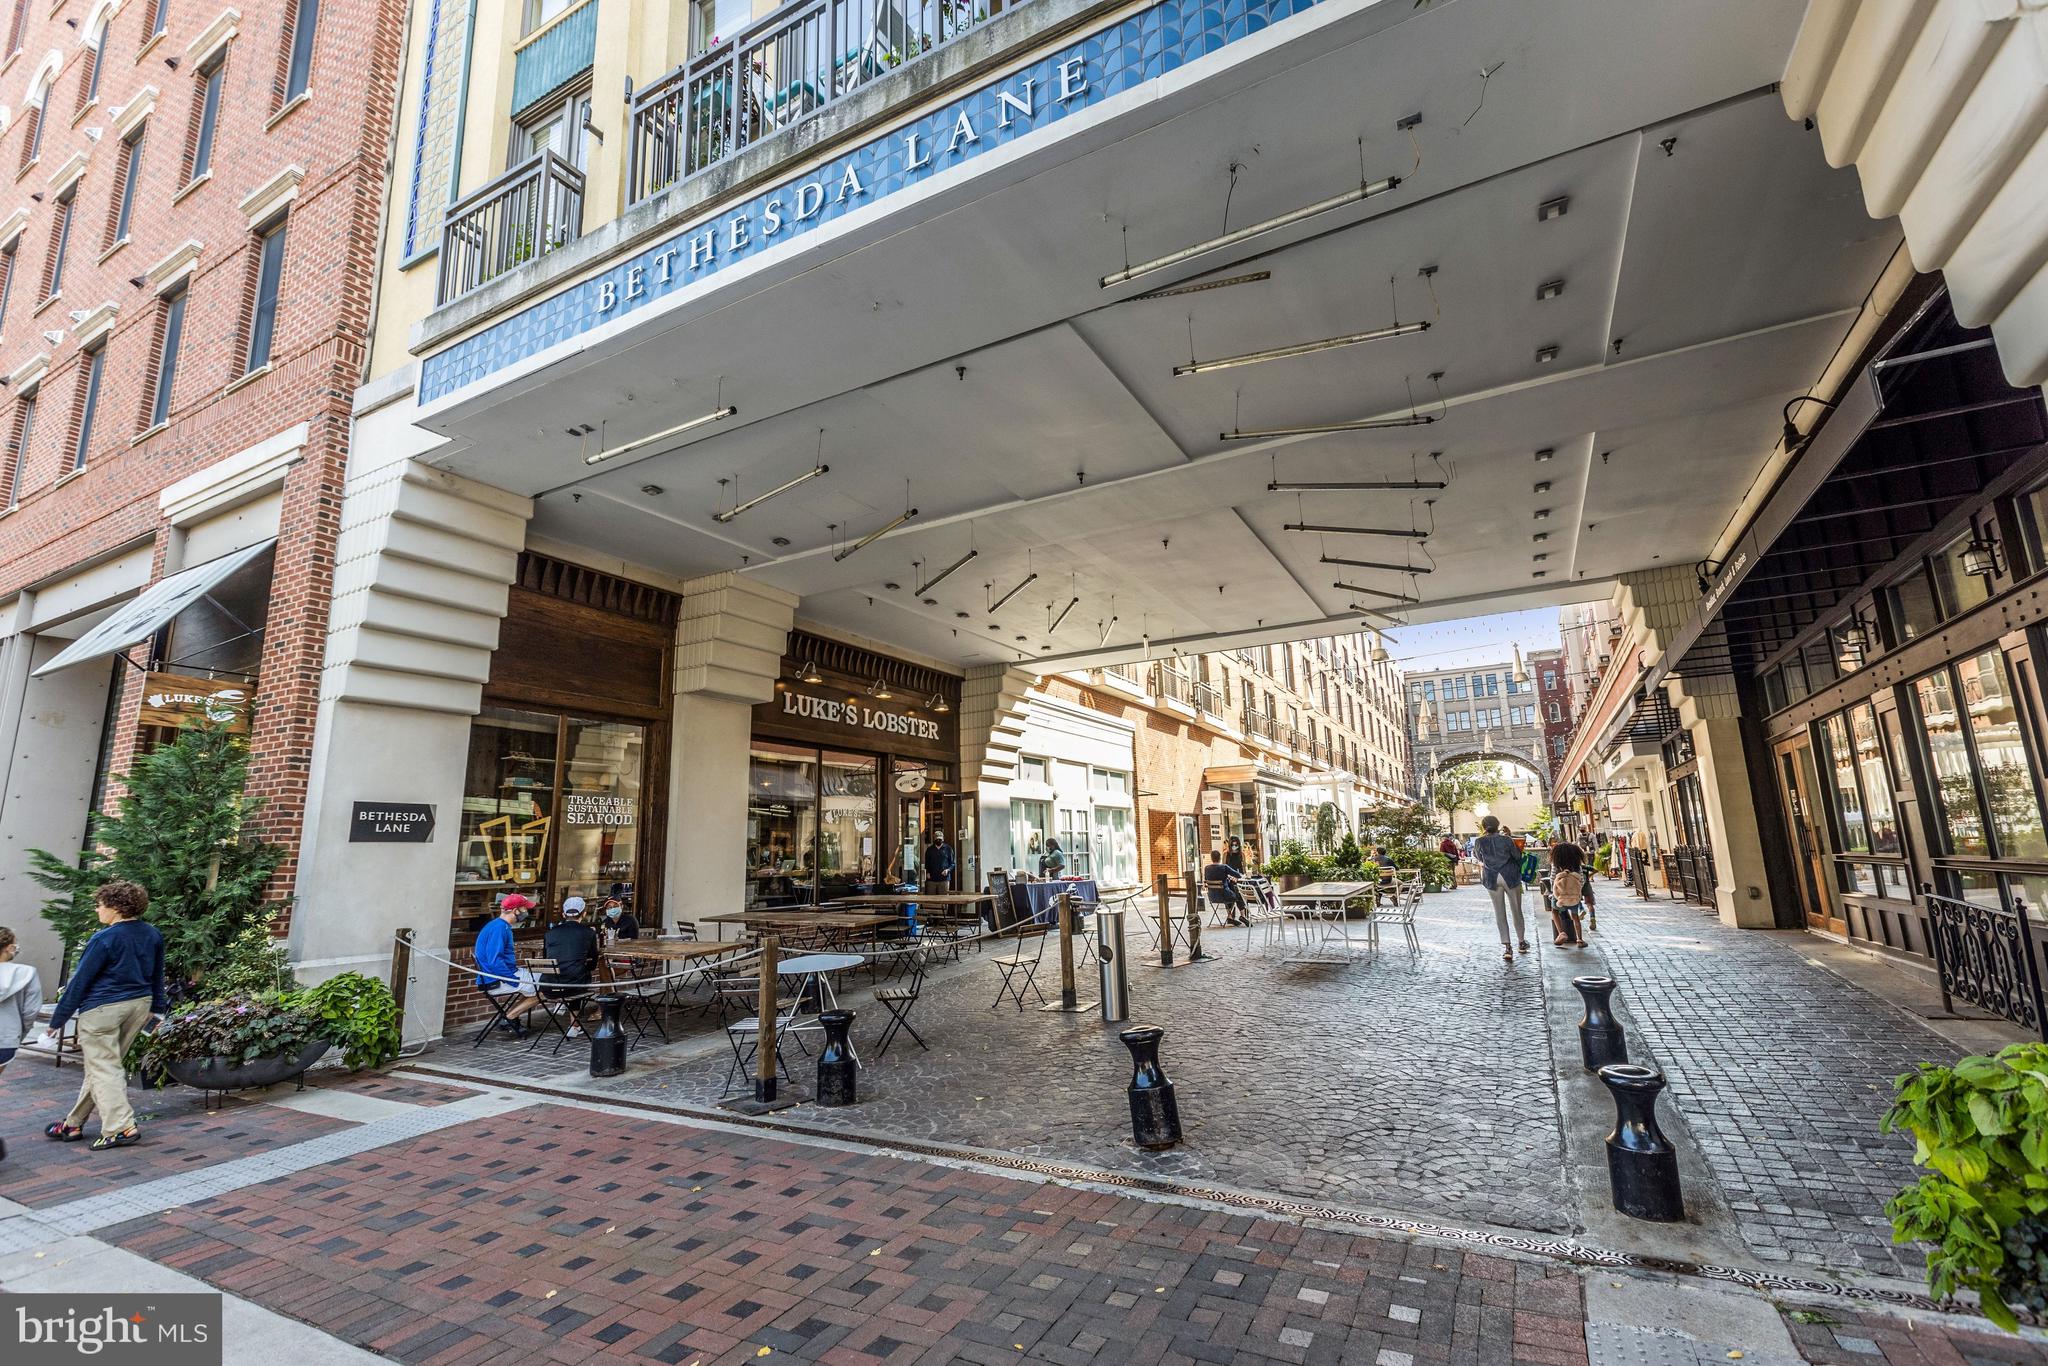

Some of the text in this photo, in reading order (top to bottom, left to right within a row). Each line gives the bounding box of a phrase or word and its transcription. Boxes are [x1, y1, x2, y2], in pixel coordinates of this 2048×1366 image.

[597, 55, 1090, 313] BETHESDA LANE
[783, 691, 940, 740] LUKE'S LOBSTER
[568, 795, 633, 807] TRACEABLE
[567, 804, 633, 815] SUSTAINABLE
[359, 811, 427, 822] BETHESDA
[375, 823, 411, 833] LANE
